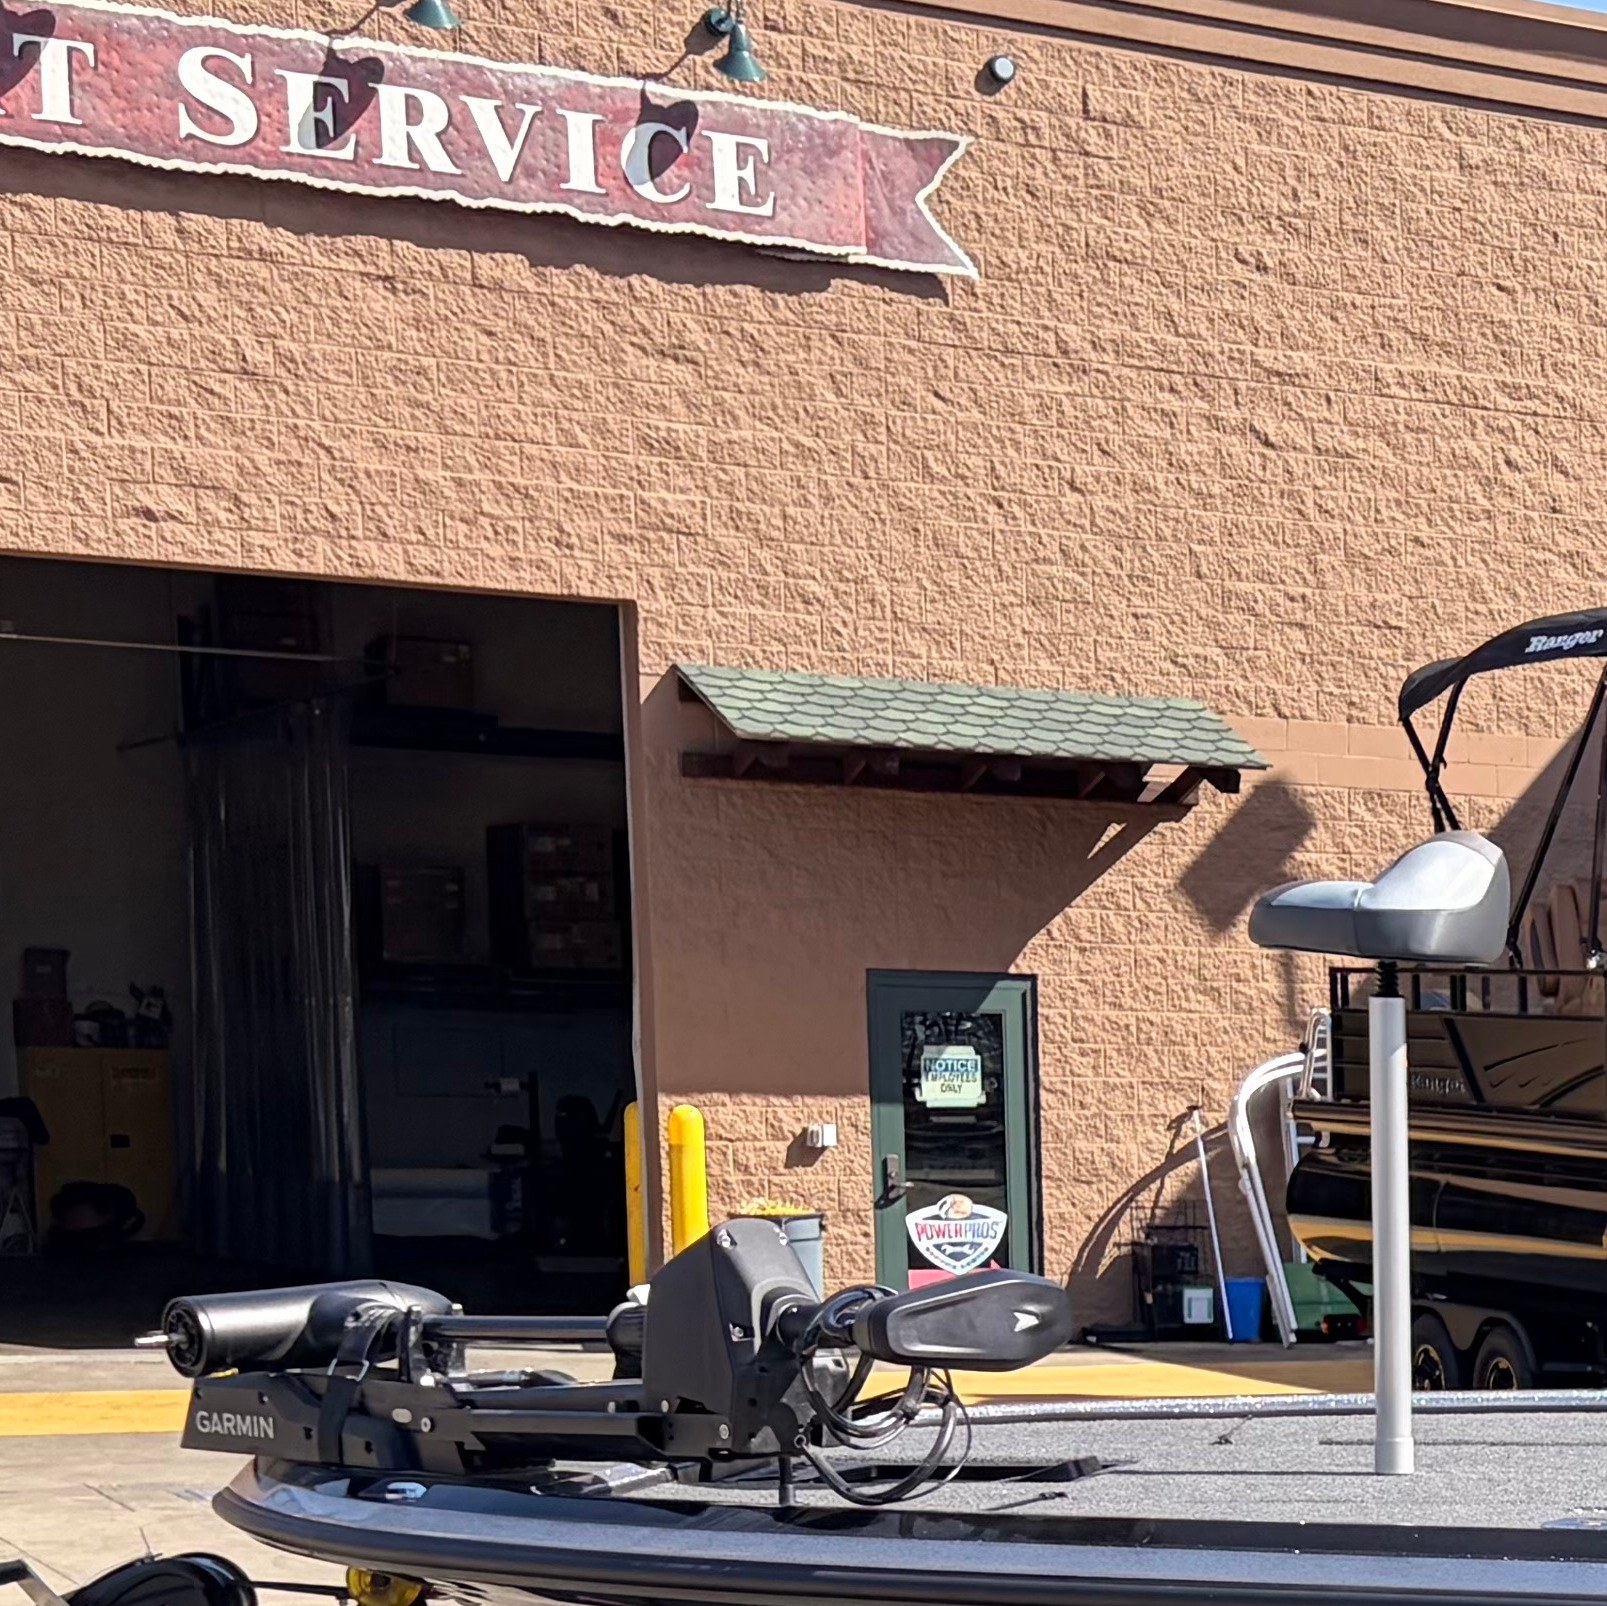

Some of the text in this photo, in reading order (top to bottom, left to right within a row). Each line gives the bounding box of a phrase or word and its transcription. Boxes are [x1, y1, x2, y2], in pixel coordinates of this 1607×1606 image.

[0, 33, 778, 218] T SERVICE
[1525, 629, 1604, 653] Ranger
[924, 1059, 977, 1072] NOTICE
[941, 1083, 962, 1093] ONLY
[195, 1410, 275, 1441] GARMIN
